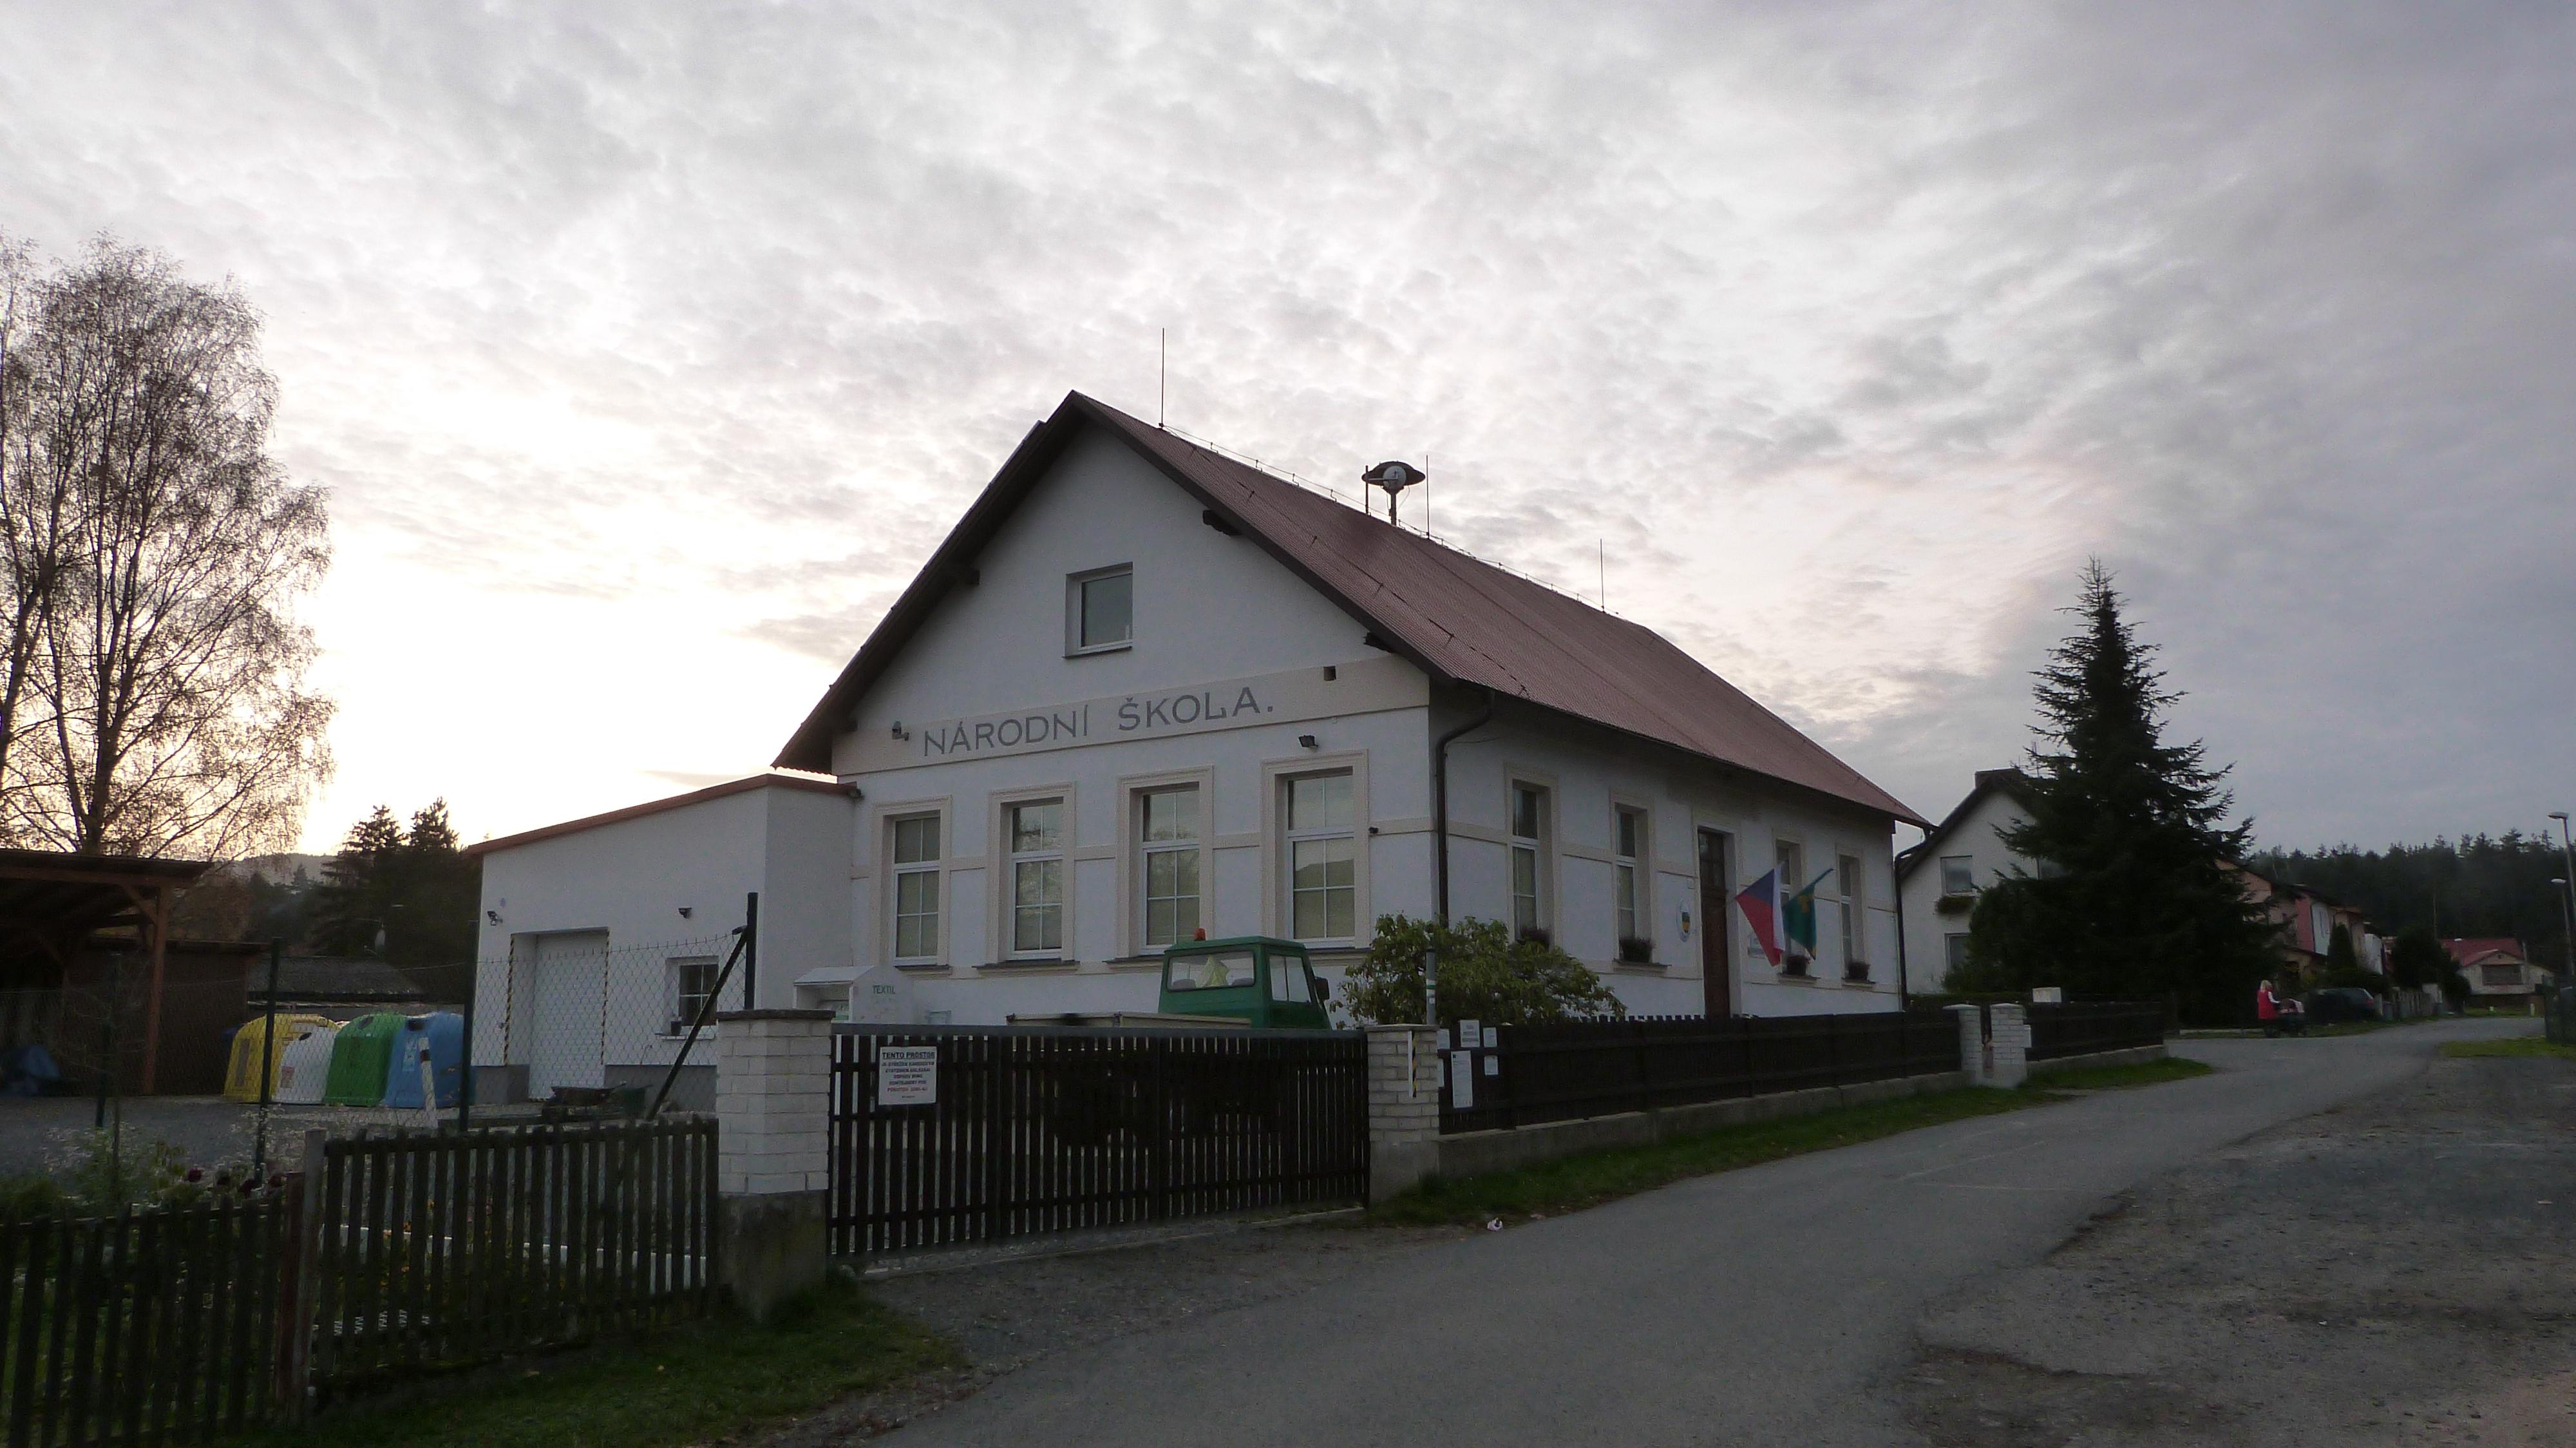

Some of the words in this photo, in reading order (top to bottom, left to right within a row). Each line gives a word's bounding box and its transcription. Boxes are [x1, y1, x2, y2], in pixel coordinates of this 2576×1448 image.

[924, 704, 1088, 756] NÁRODNÍ
[1118, 687, 1273, 731] ŠKOLA.
[873, 985, 896, 995] TEXTIL
